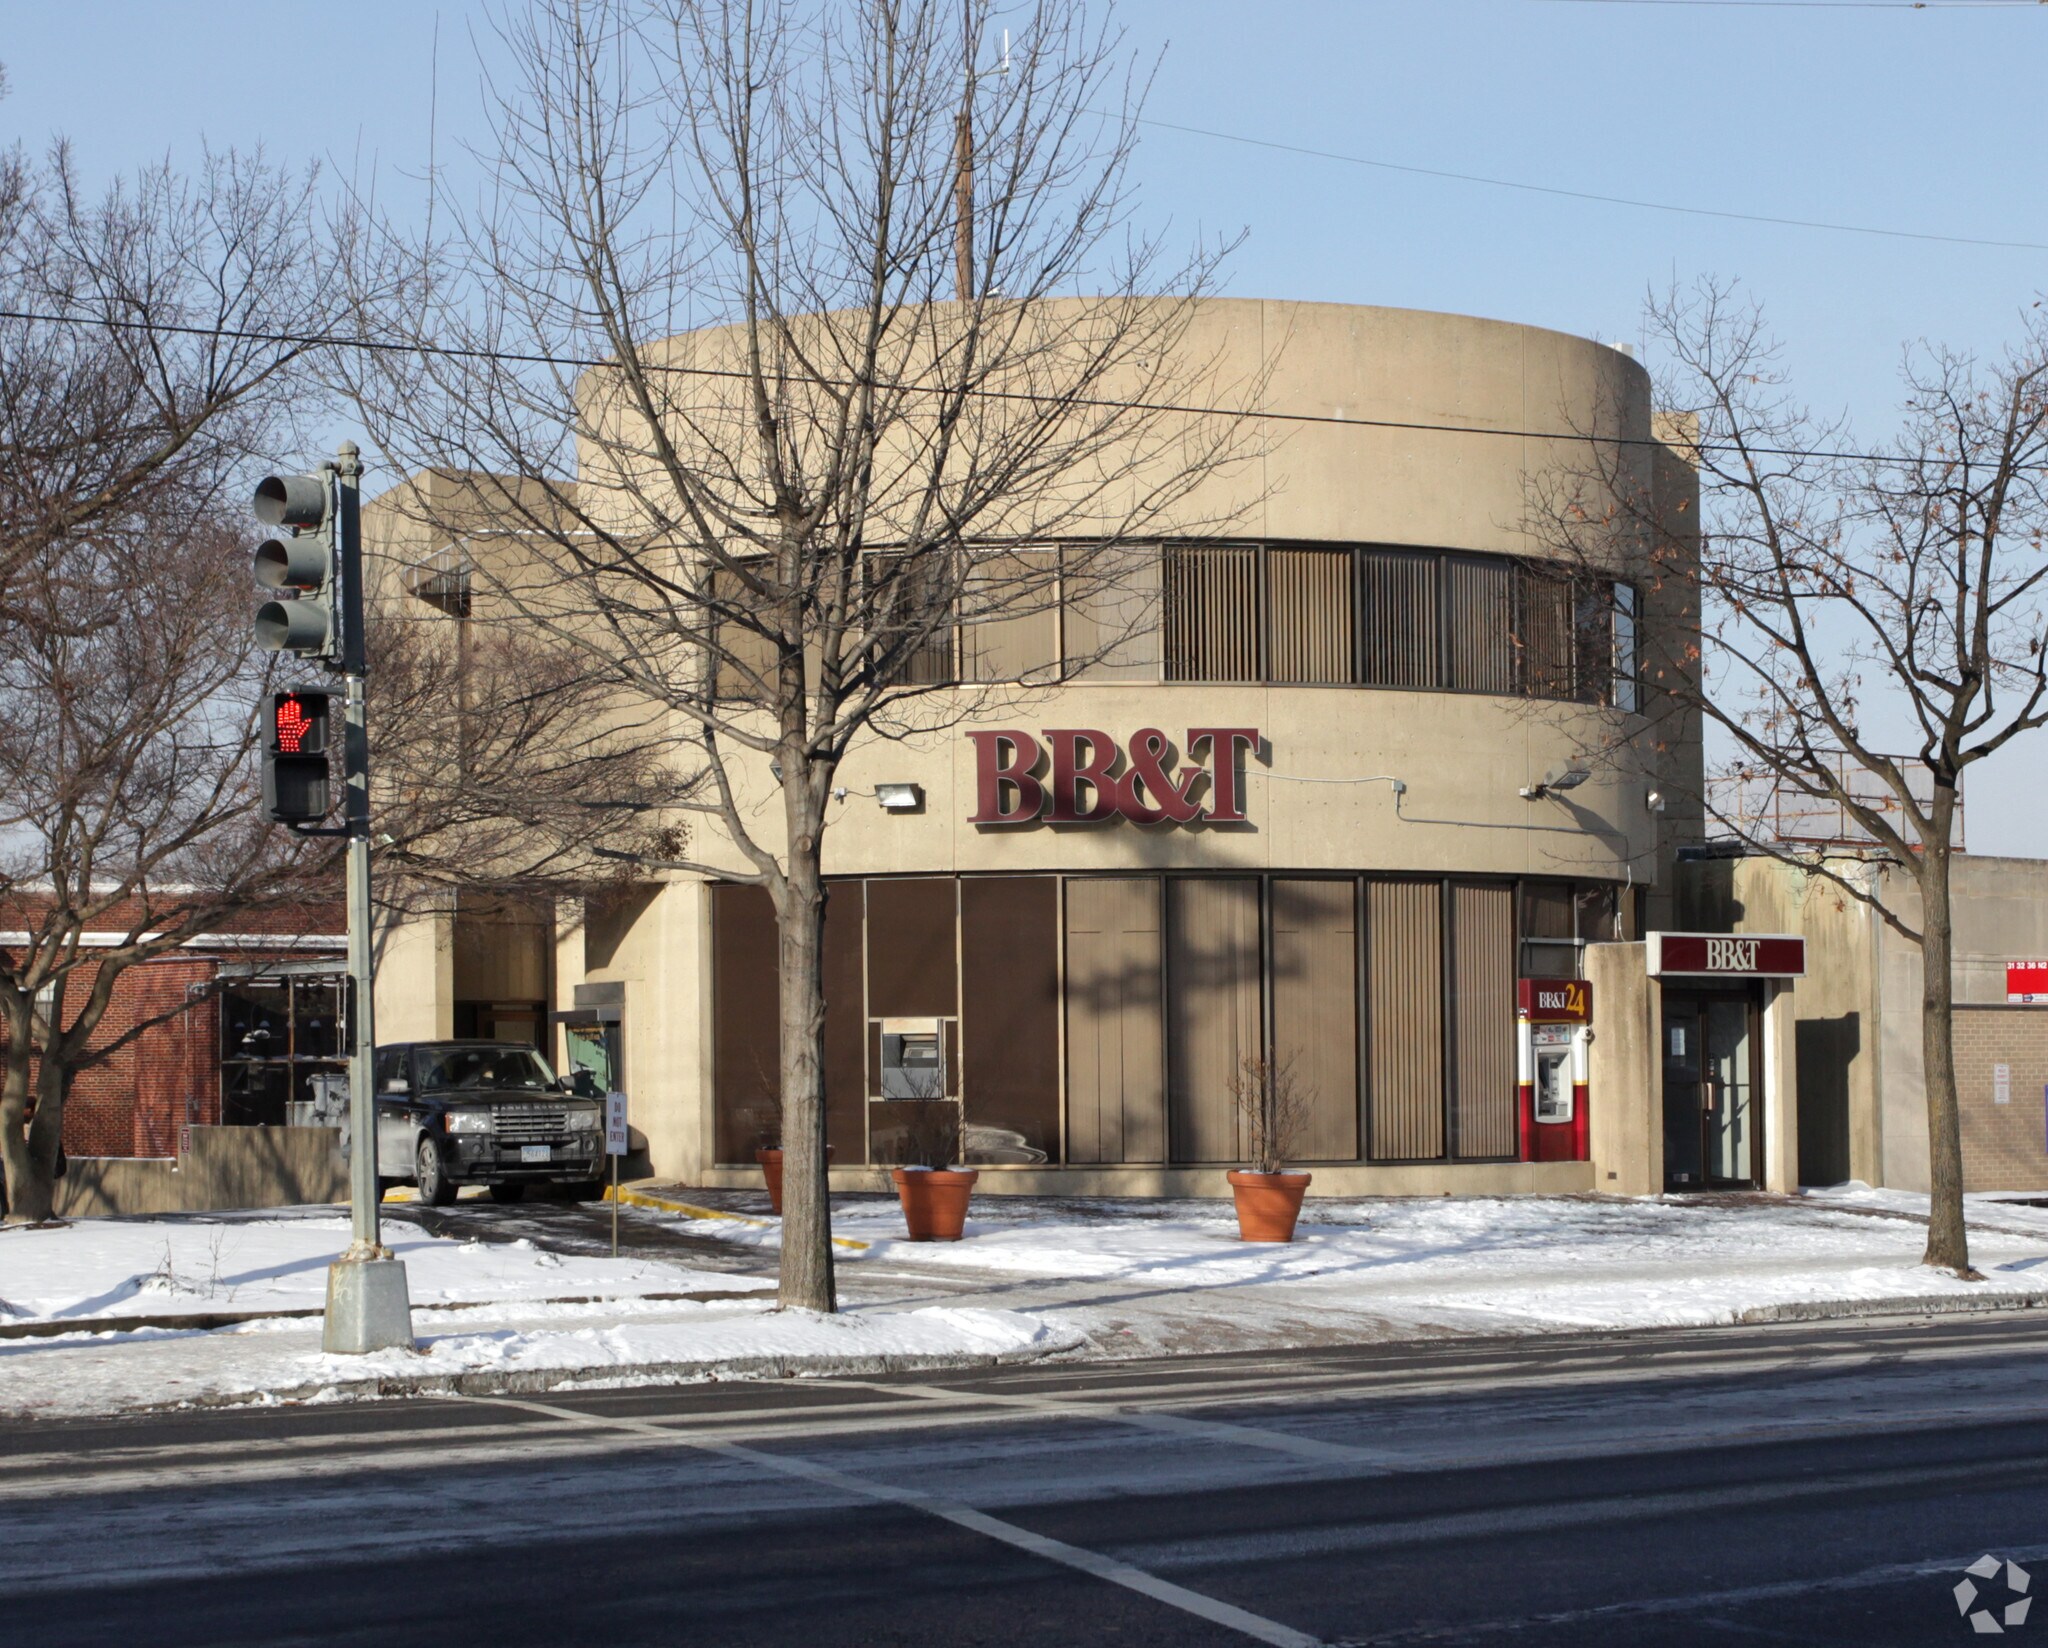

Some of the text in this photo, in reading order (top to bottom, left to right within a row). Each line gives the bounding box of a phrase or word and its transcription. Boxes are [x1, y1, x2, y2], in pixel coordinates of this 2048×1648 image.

[965, 728, 1260, 824] BB&T
[1705, 939, 1761, 971] BB&T
[2007, 961, 2015, 970] 31
[2016, 961, 2026, 970] 32
[1538, 983, 1585, 1016] BB&T 24
[614, 1102, 622, 1113] DO
[612, 1116, 622, 1128] NOT
[609, 1131, 625, 1143] ENTER
